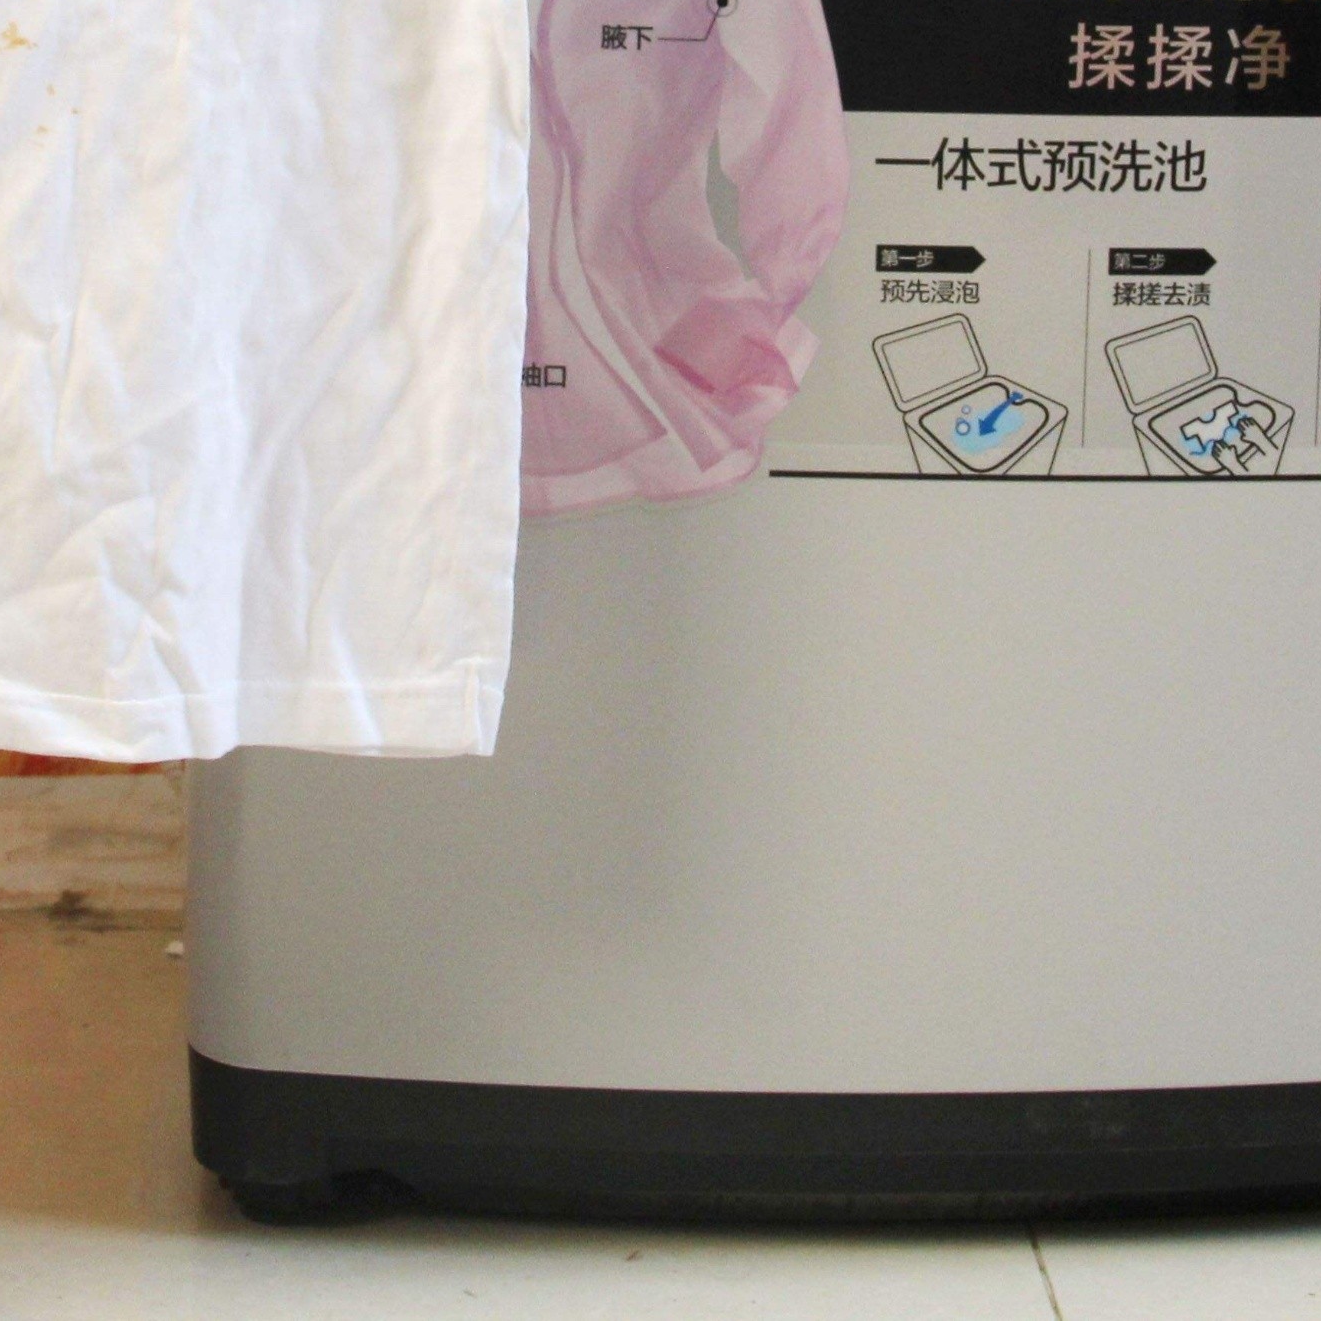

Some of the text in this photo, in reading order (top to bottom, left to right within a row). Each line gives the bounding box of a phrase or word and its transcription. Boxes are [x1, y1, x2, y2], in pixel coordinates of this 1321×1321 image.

[600, 24, 654, 50] 腋下
[1068, 22, 1291, 91] 揉揉净
[875, 136, 1208, 193] 一体式预洗池
[880, 249, 935, 269] 第一步
[1113, 252, 1167, 271] 第二步
[880, 279, 981, 304] 预先浸泡
[1113, 282, 1212, 307] 揉搓去渍
